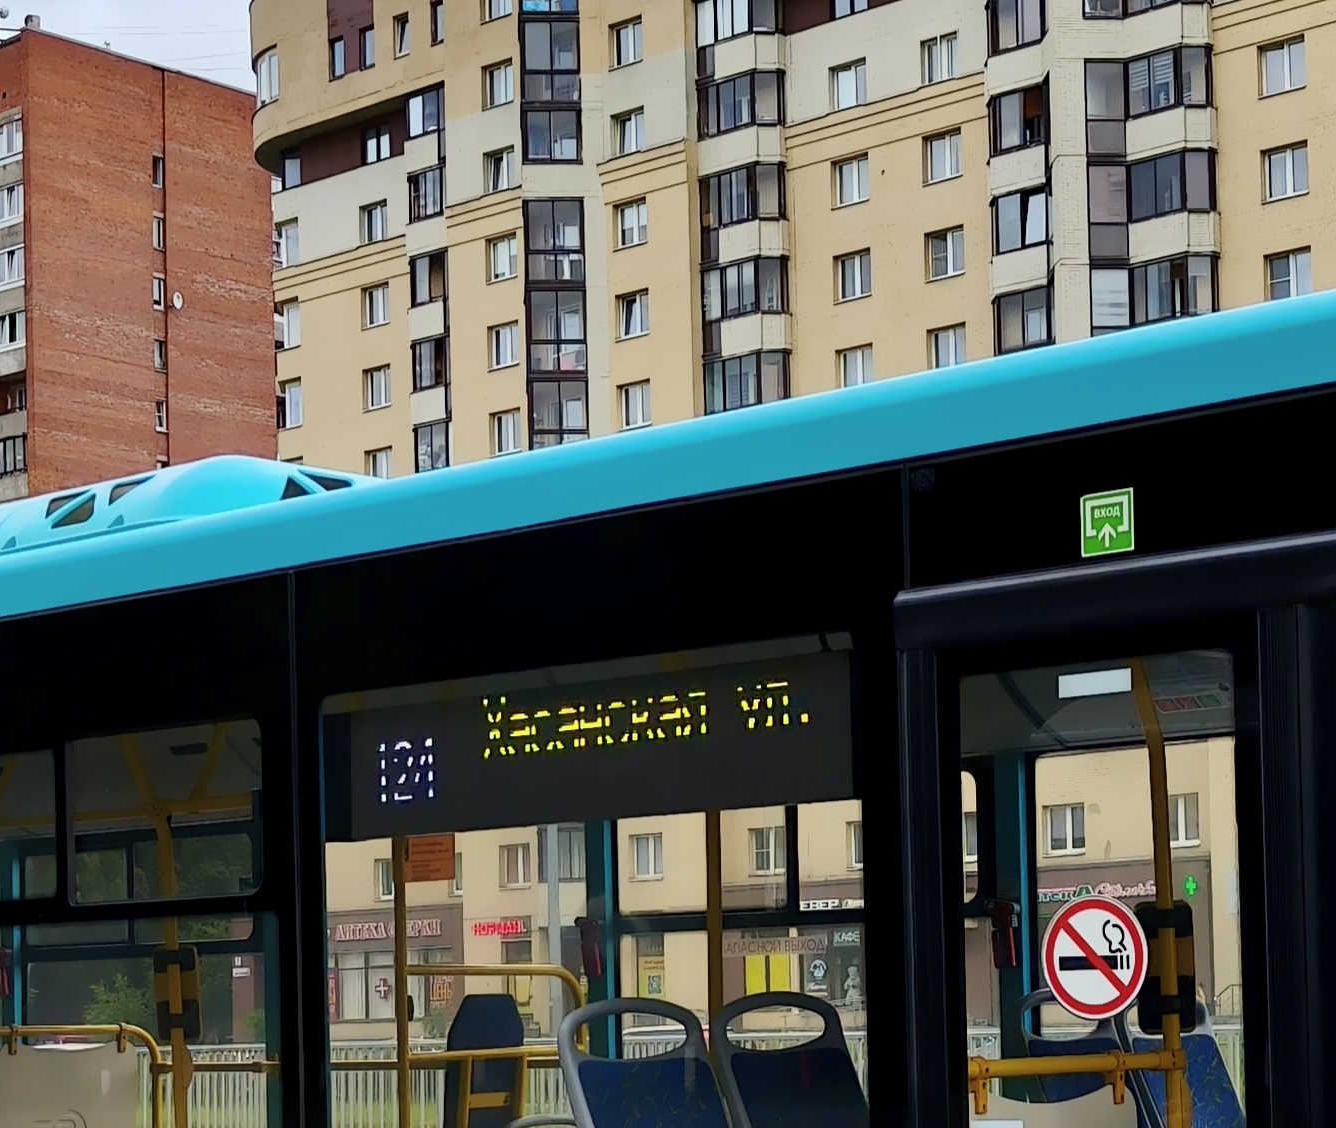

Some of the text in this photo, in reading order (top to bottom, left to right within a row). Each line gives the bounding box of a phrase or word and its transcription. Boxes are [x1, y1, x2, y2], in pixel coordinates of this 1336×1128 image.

[1094, 505, 1120, 519] ВХОД
[377, 737, 435, 802] 124
[335, 922, 387, 942] АПТЕКА
[833, 930, 860, 943] КАФЕ
[722, 938, 827, 955] АПАСНОЙ ВЫХОД
